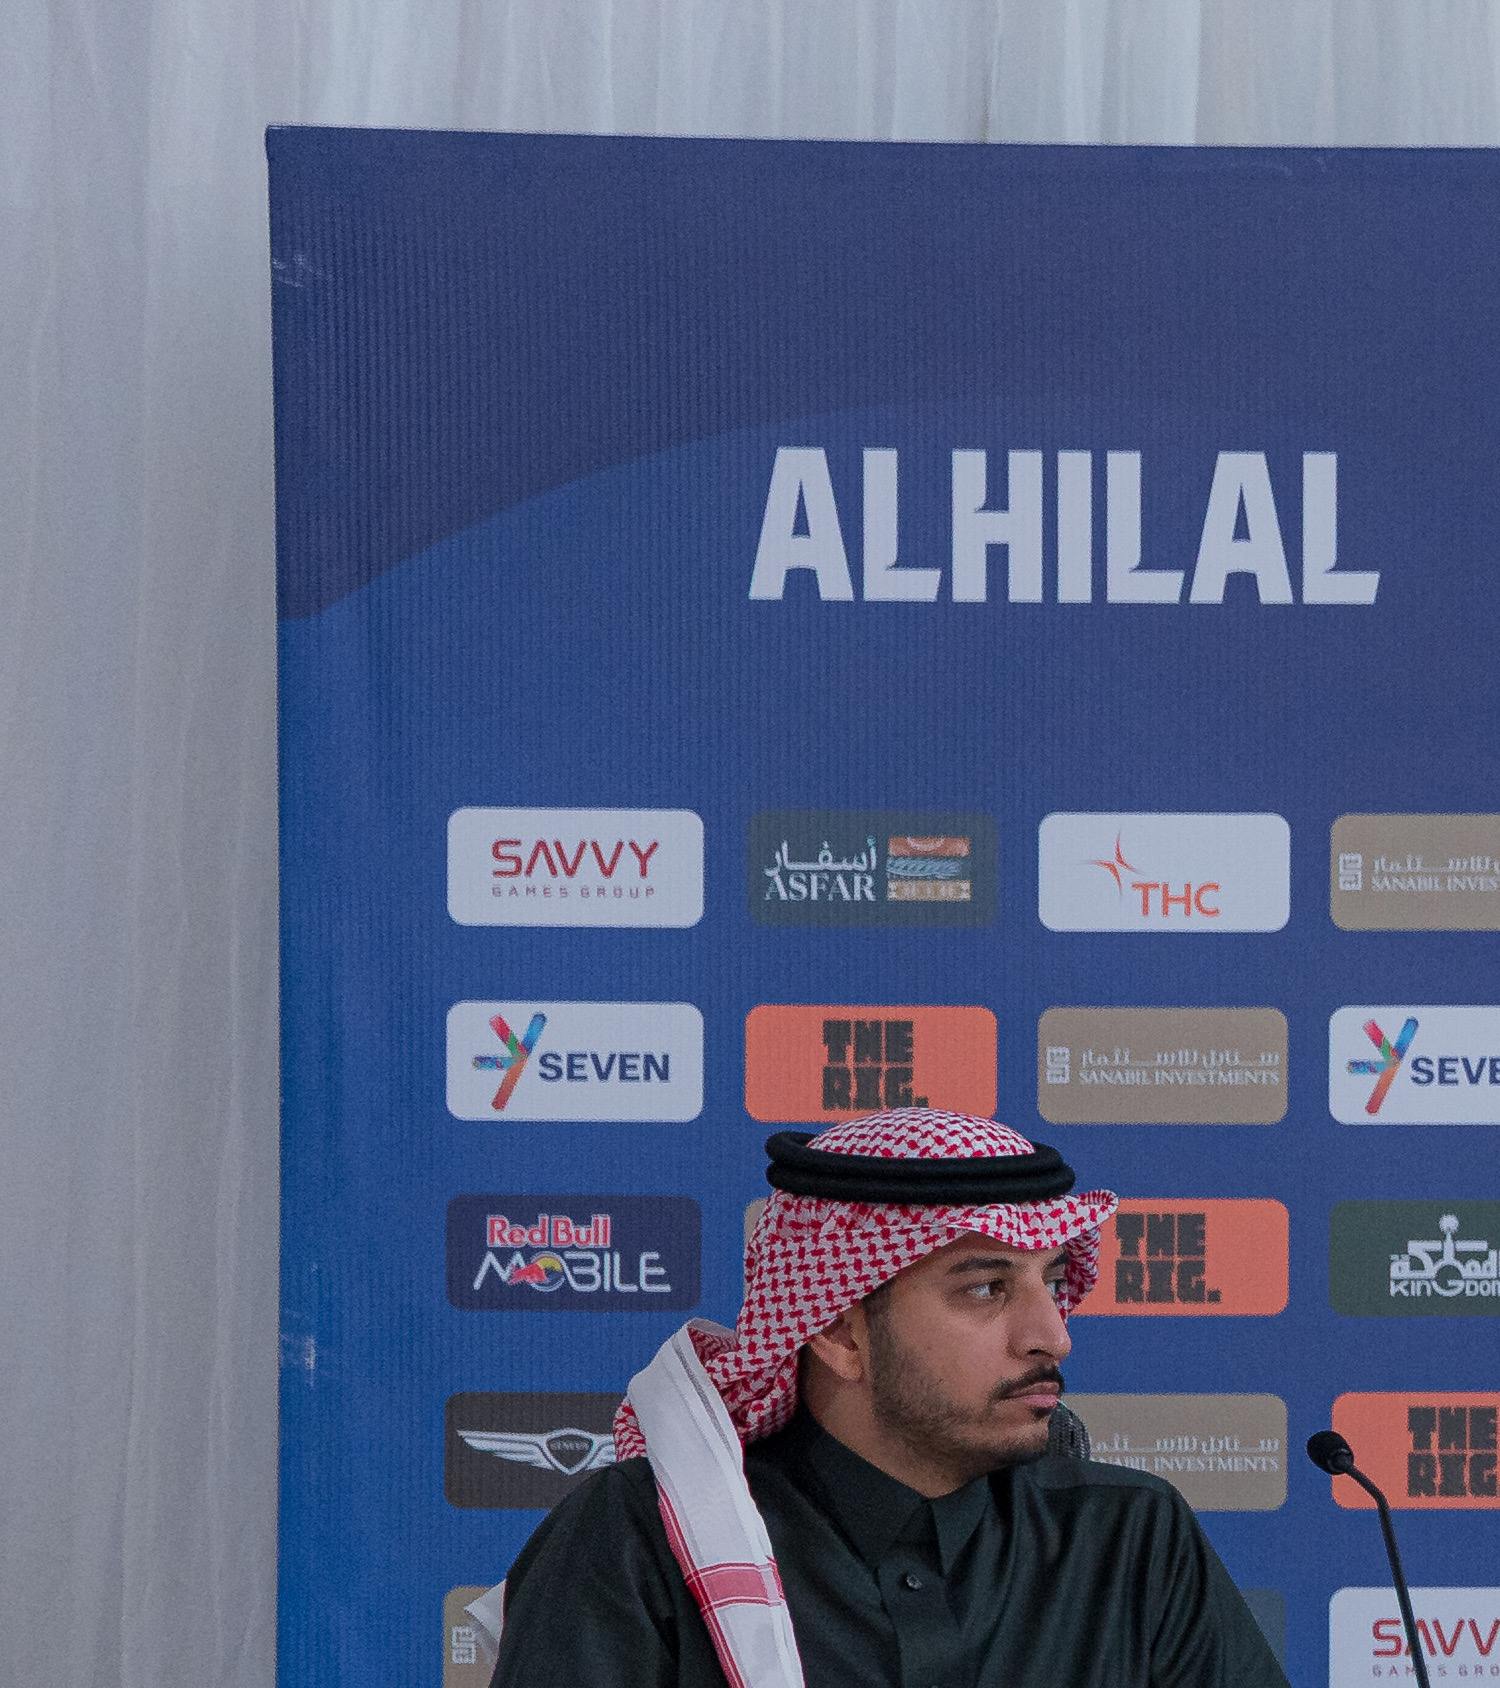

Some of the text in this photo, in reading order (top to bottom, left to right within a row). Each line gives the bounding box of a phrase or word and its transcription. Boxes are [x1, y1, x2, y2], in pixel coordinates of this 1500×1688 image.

[748, 445, 1381, 605] ALHILAL
[491, 839, 659, 879] SAVVY
[764, 875, 875, 902] ASFAR
[1132, 882, 1223, 918] THC
[823, 1019, 913, 1065] THE
[540, 1052, 670, 1083] SEVEN
[486, 1213, 611, 1248] Red Bull
[1116, 1213, 1206, 1259] THE
[473, 1250, 671, 1292] MOBILE
[1408, 1406, 1498, 1452] THE
